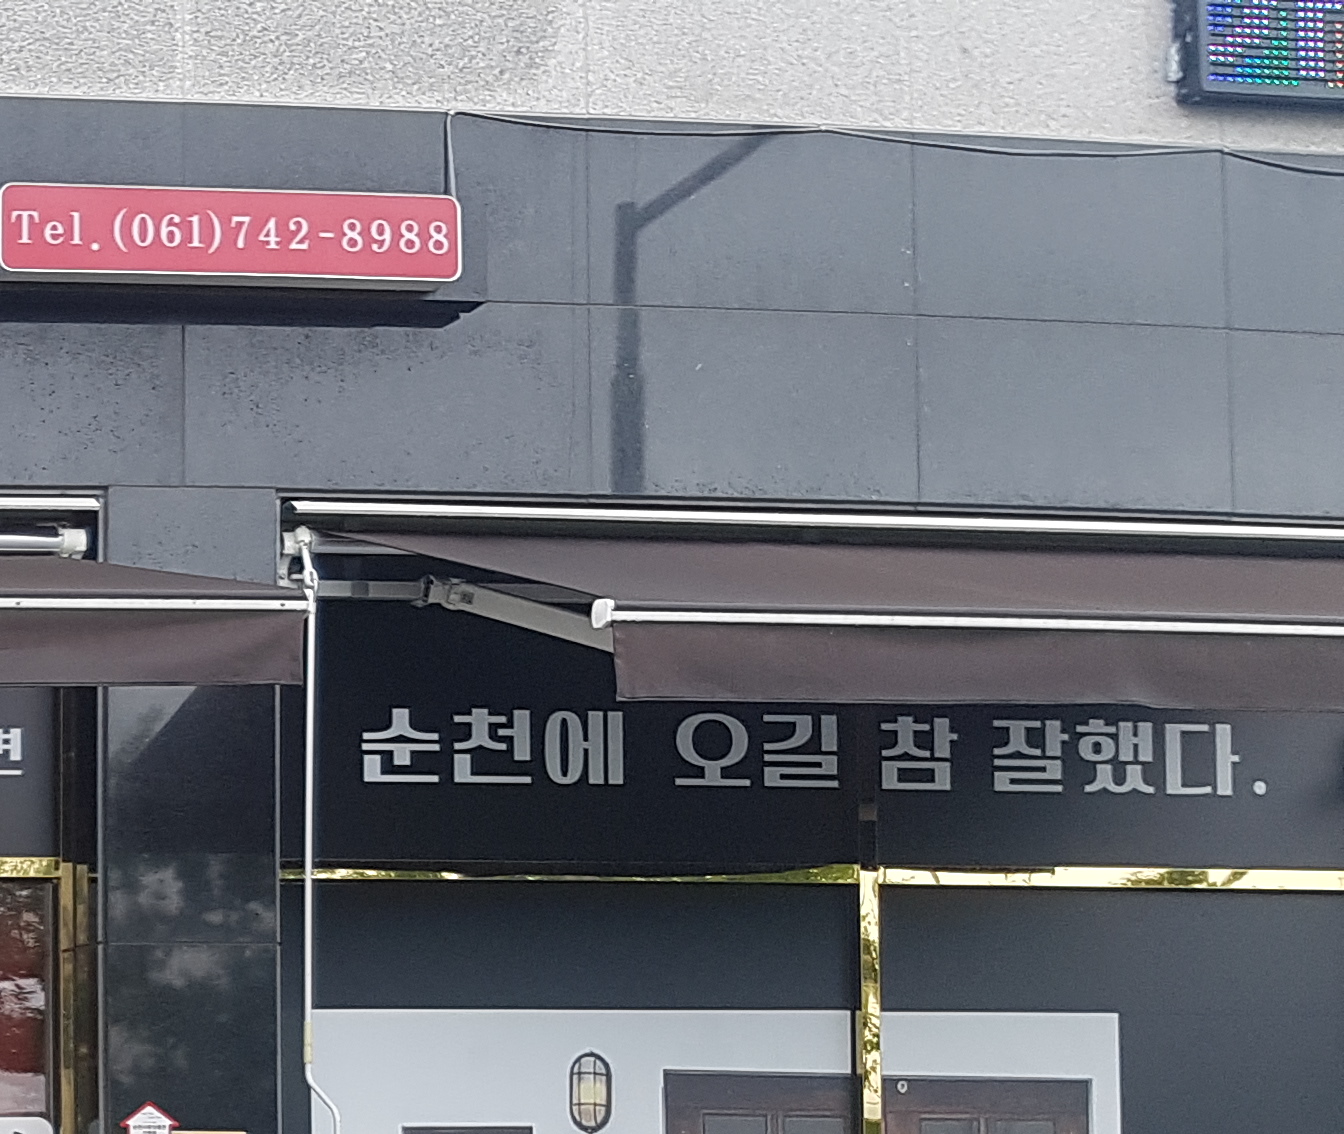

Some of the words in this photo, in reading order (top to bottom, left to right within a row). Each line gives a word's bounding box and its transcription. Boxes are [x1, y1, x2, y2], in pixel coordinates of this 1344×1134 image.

[360, 708, 625, 786] 순천에
[674, 712, 840, 789] 오길
[880, 716, 958, 791] 참
[993, 717, 1267, 797] 잘했다.
